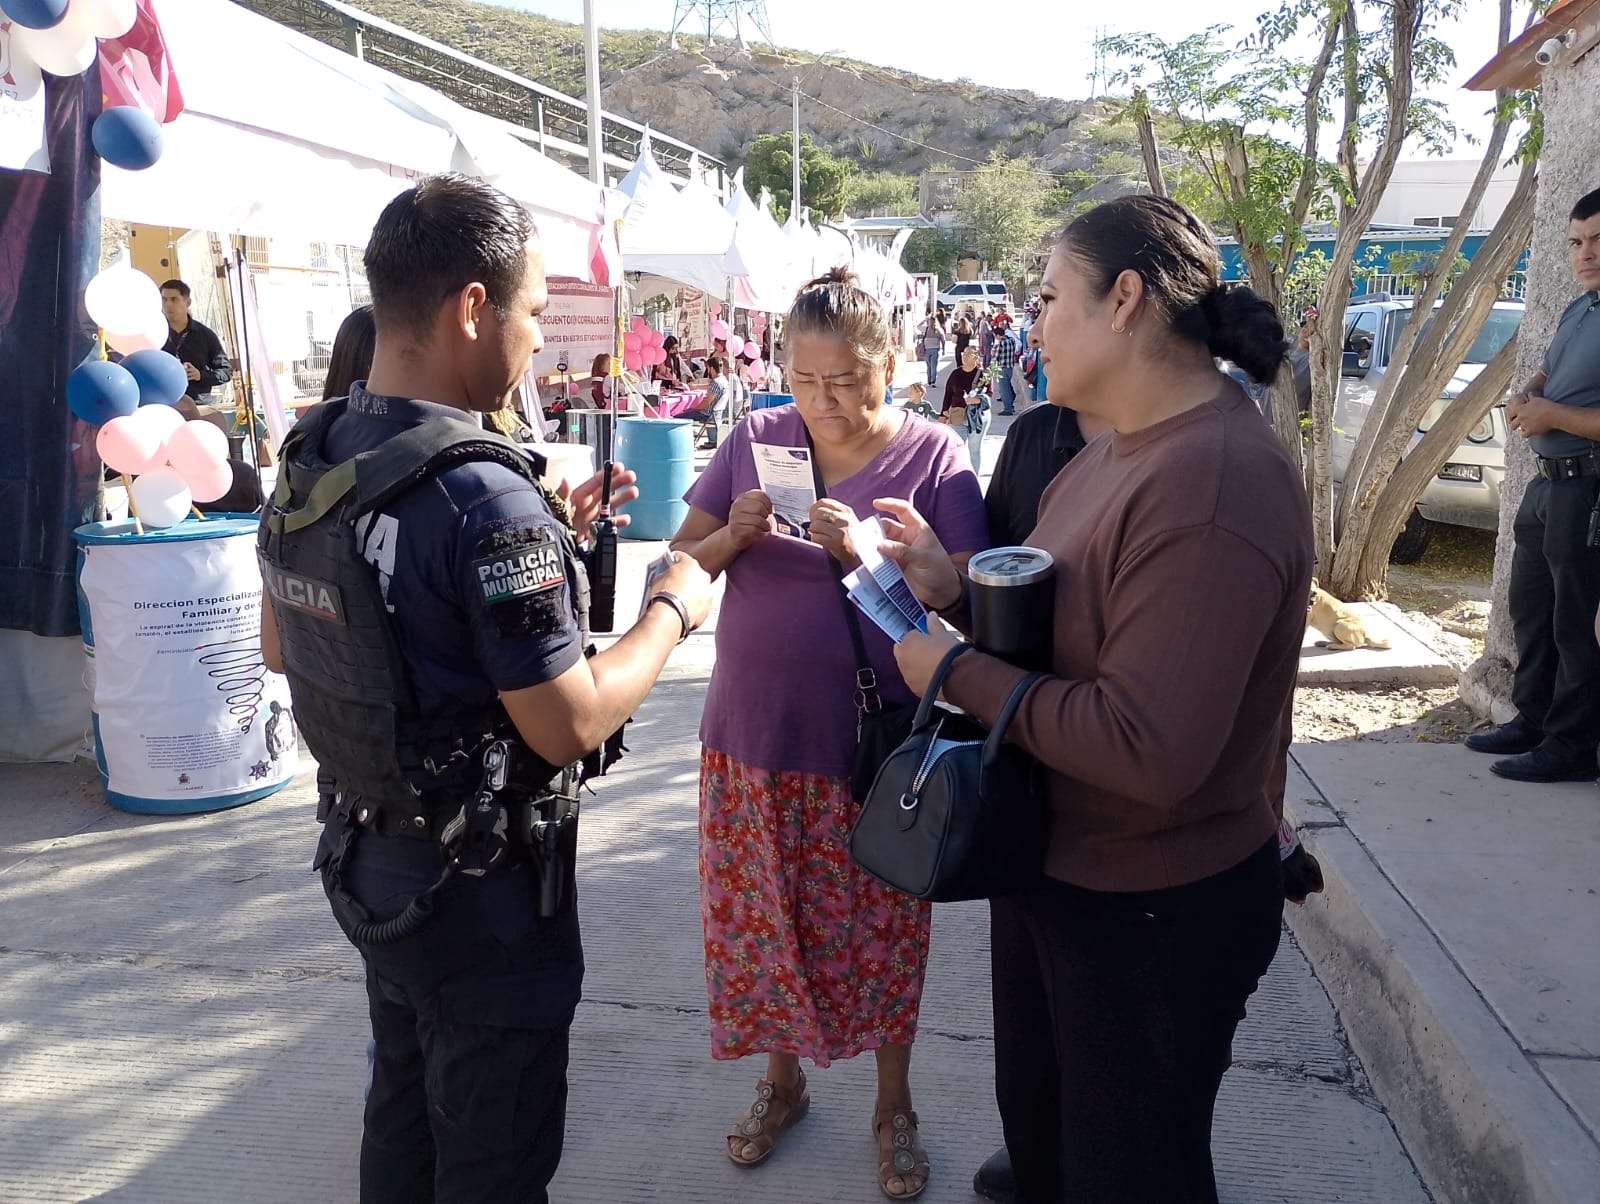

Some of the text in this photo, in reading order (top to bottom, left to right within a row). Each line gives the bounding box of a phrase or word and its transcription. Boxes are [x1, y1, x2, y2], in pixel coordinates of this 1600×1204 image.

[482, 564, 562, 598] MUNICIPAL
[134, 600, 194, 610] Direccion
[182, 607, 232, 619] Familiar
[235, 606, 242, 614] y
